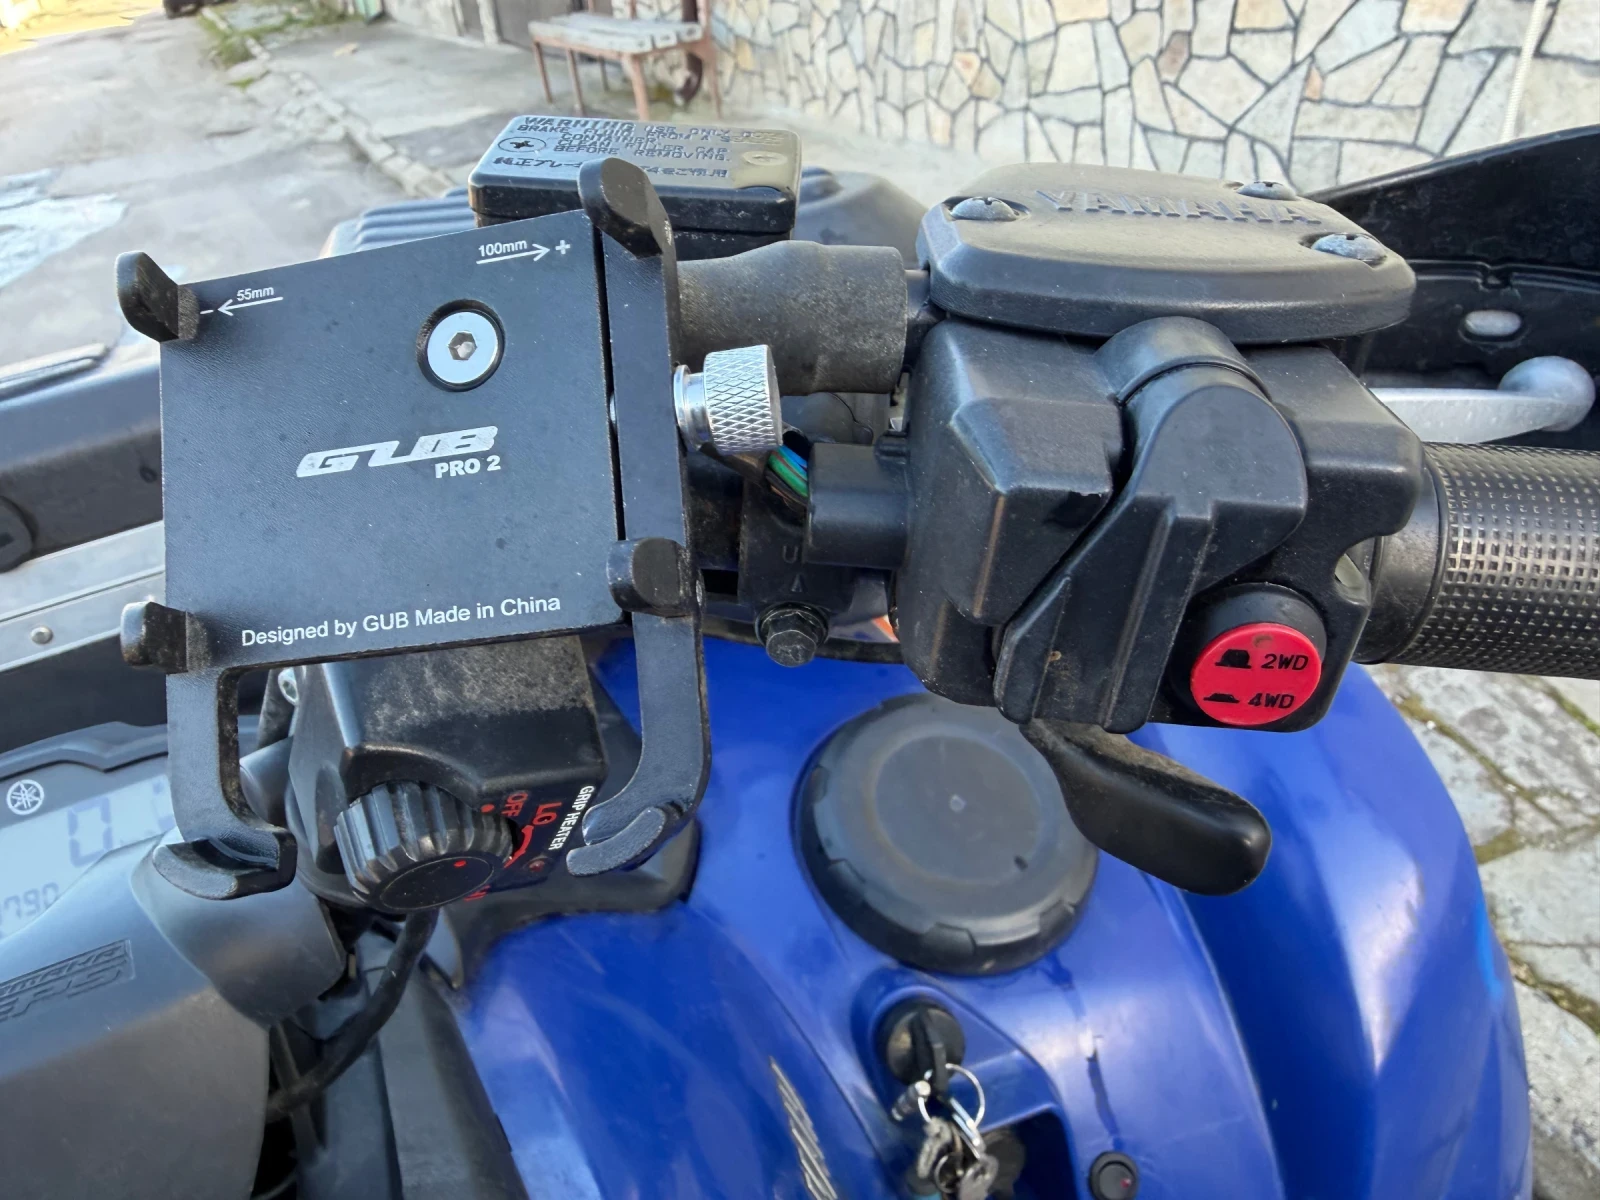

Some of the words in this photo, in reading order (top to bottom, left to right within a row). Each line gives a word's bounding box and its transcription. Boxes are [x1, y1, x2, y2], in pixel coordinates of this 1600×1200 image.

[517, 125, 573, 134] BRAKE
[524, 117, 636, 131] WARNING
[553, 145, 620, 155] BEFORE
[557, 140, 611, 148] CLEAN
[478, 239, 528, 259] 100mm
[236, 286, 274, 302] 55mm
[435, 460, 480, 479] PRO
[482, 455, 501, 472] 2
[241, 621, 329, 647] Designed
[334, 618, 358, 639] by
[362, 611, 409, 633] GUB
[415, 605, 471, 627] Made
[476, 602, 494, 620] in
[500, 596, 561, 617] China
[1261, 653, 1309, 671] 2WD
[1247, 692, 1295, 709] 4WD
[502, 791, 529, 818] OFF
[571, 785, 595, 815] GRIP
[532, 802, 563, 826] LO
[548, 811, 579, 851] HEATER
[0, 881, 60, 923] 790
